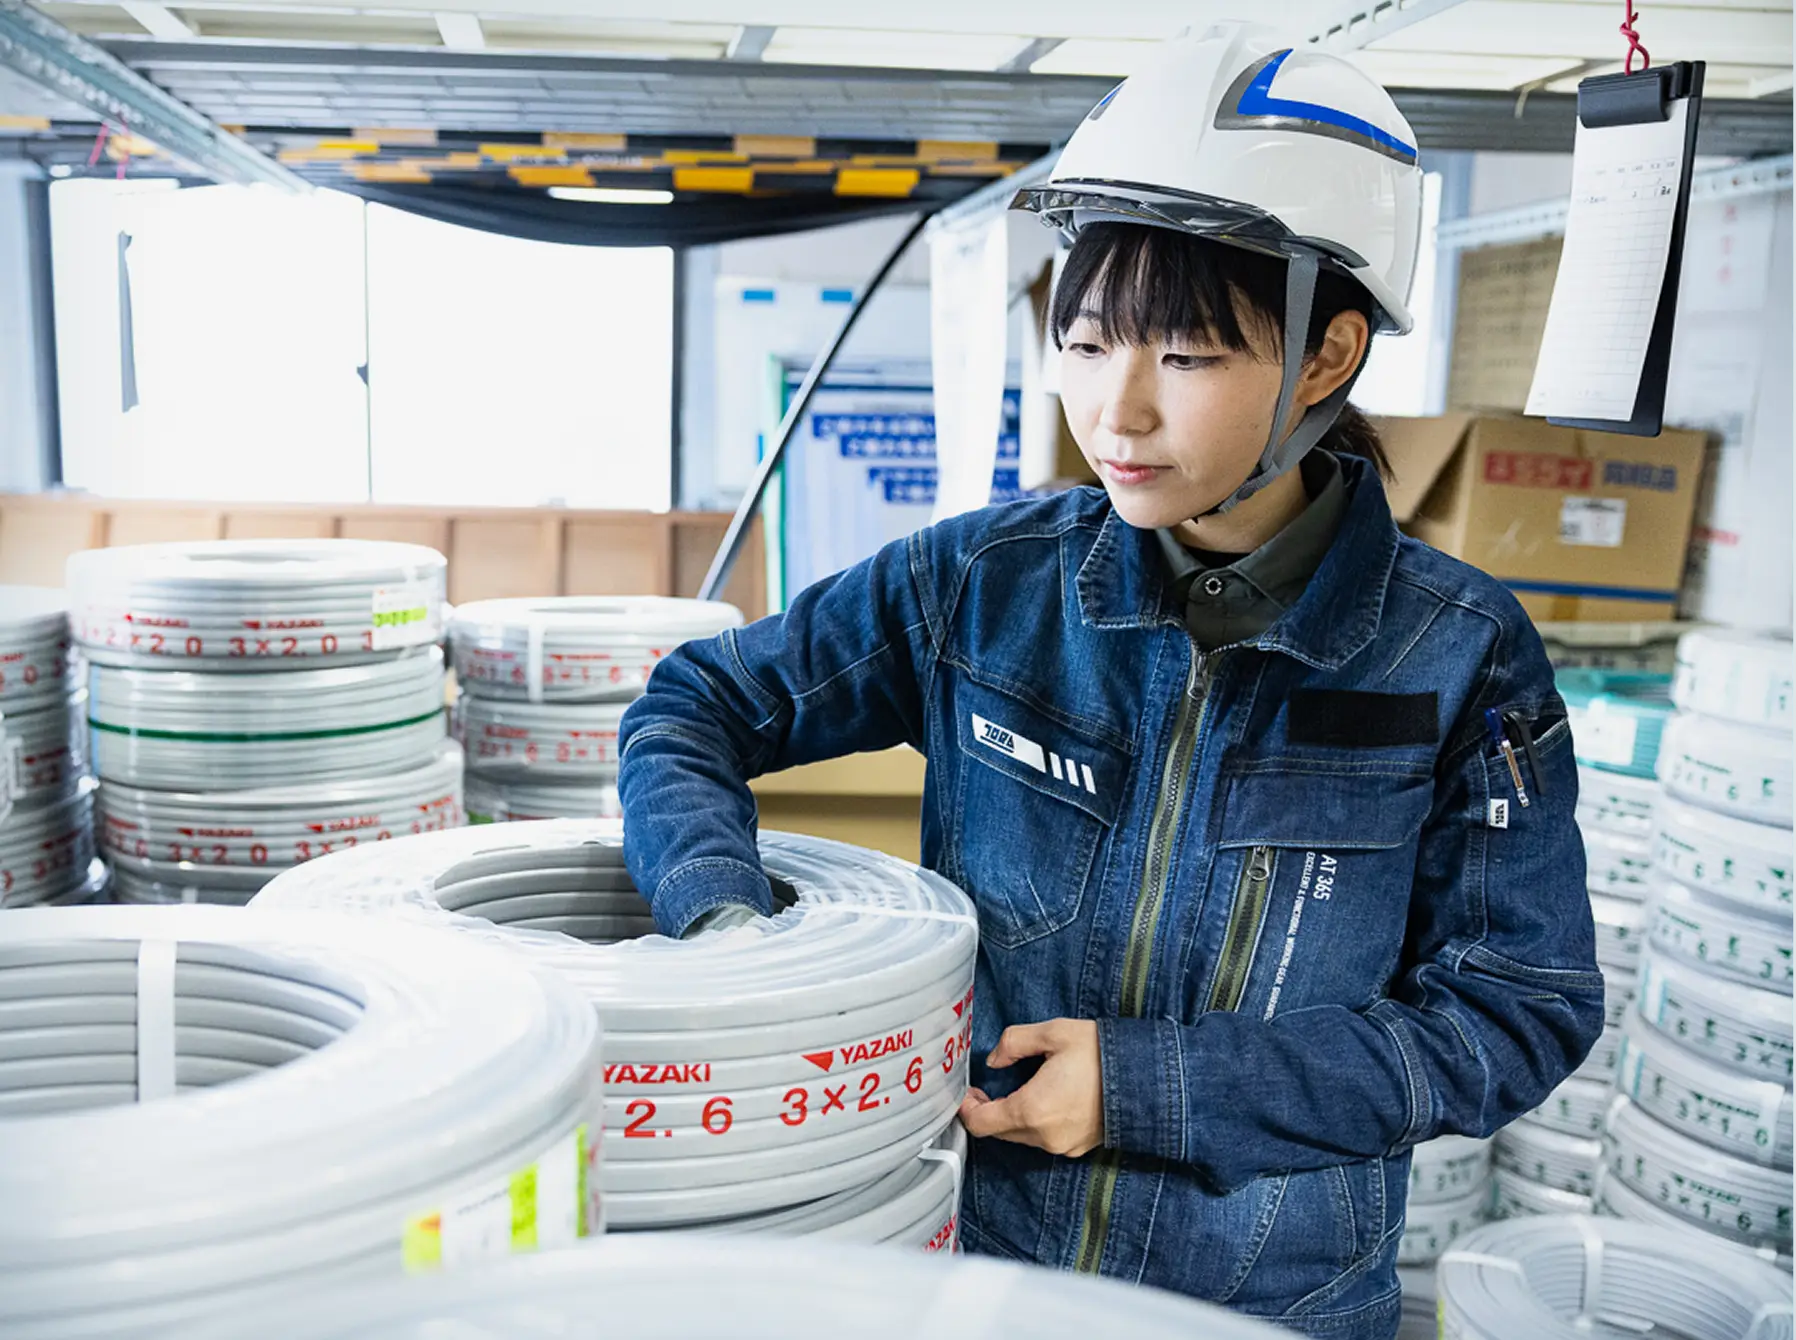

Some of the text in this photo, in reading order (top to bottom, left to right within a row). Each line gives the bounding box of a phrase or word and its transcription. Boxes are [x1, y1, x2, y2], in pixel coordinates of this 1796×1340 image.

[1313, 853, 1338, 901] AT 365
[840, 1029, 914, 1066] YAZAKI
[604, 1063, 711, 1084] YAZAKI
